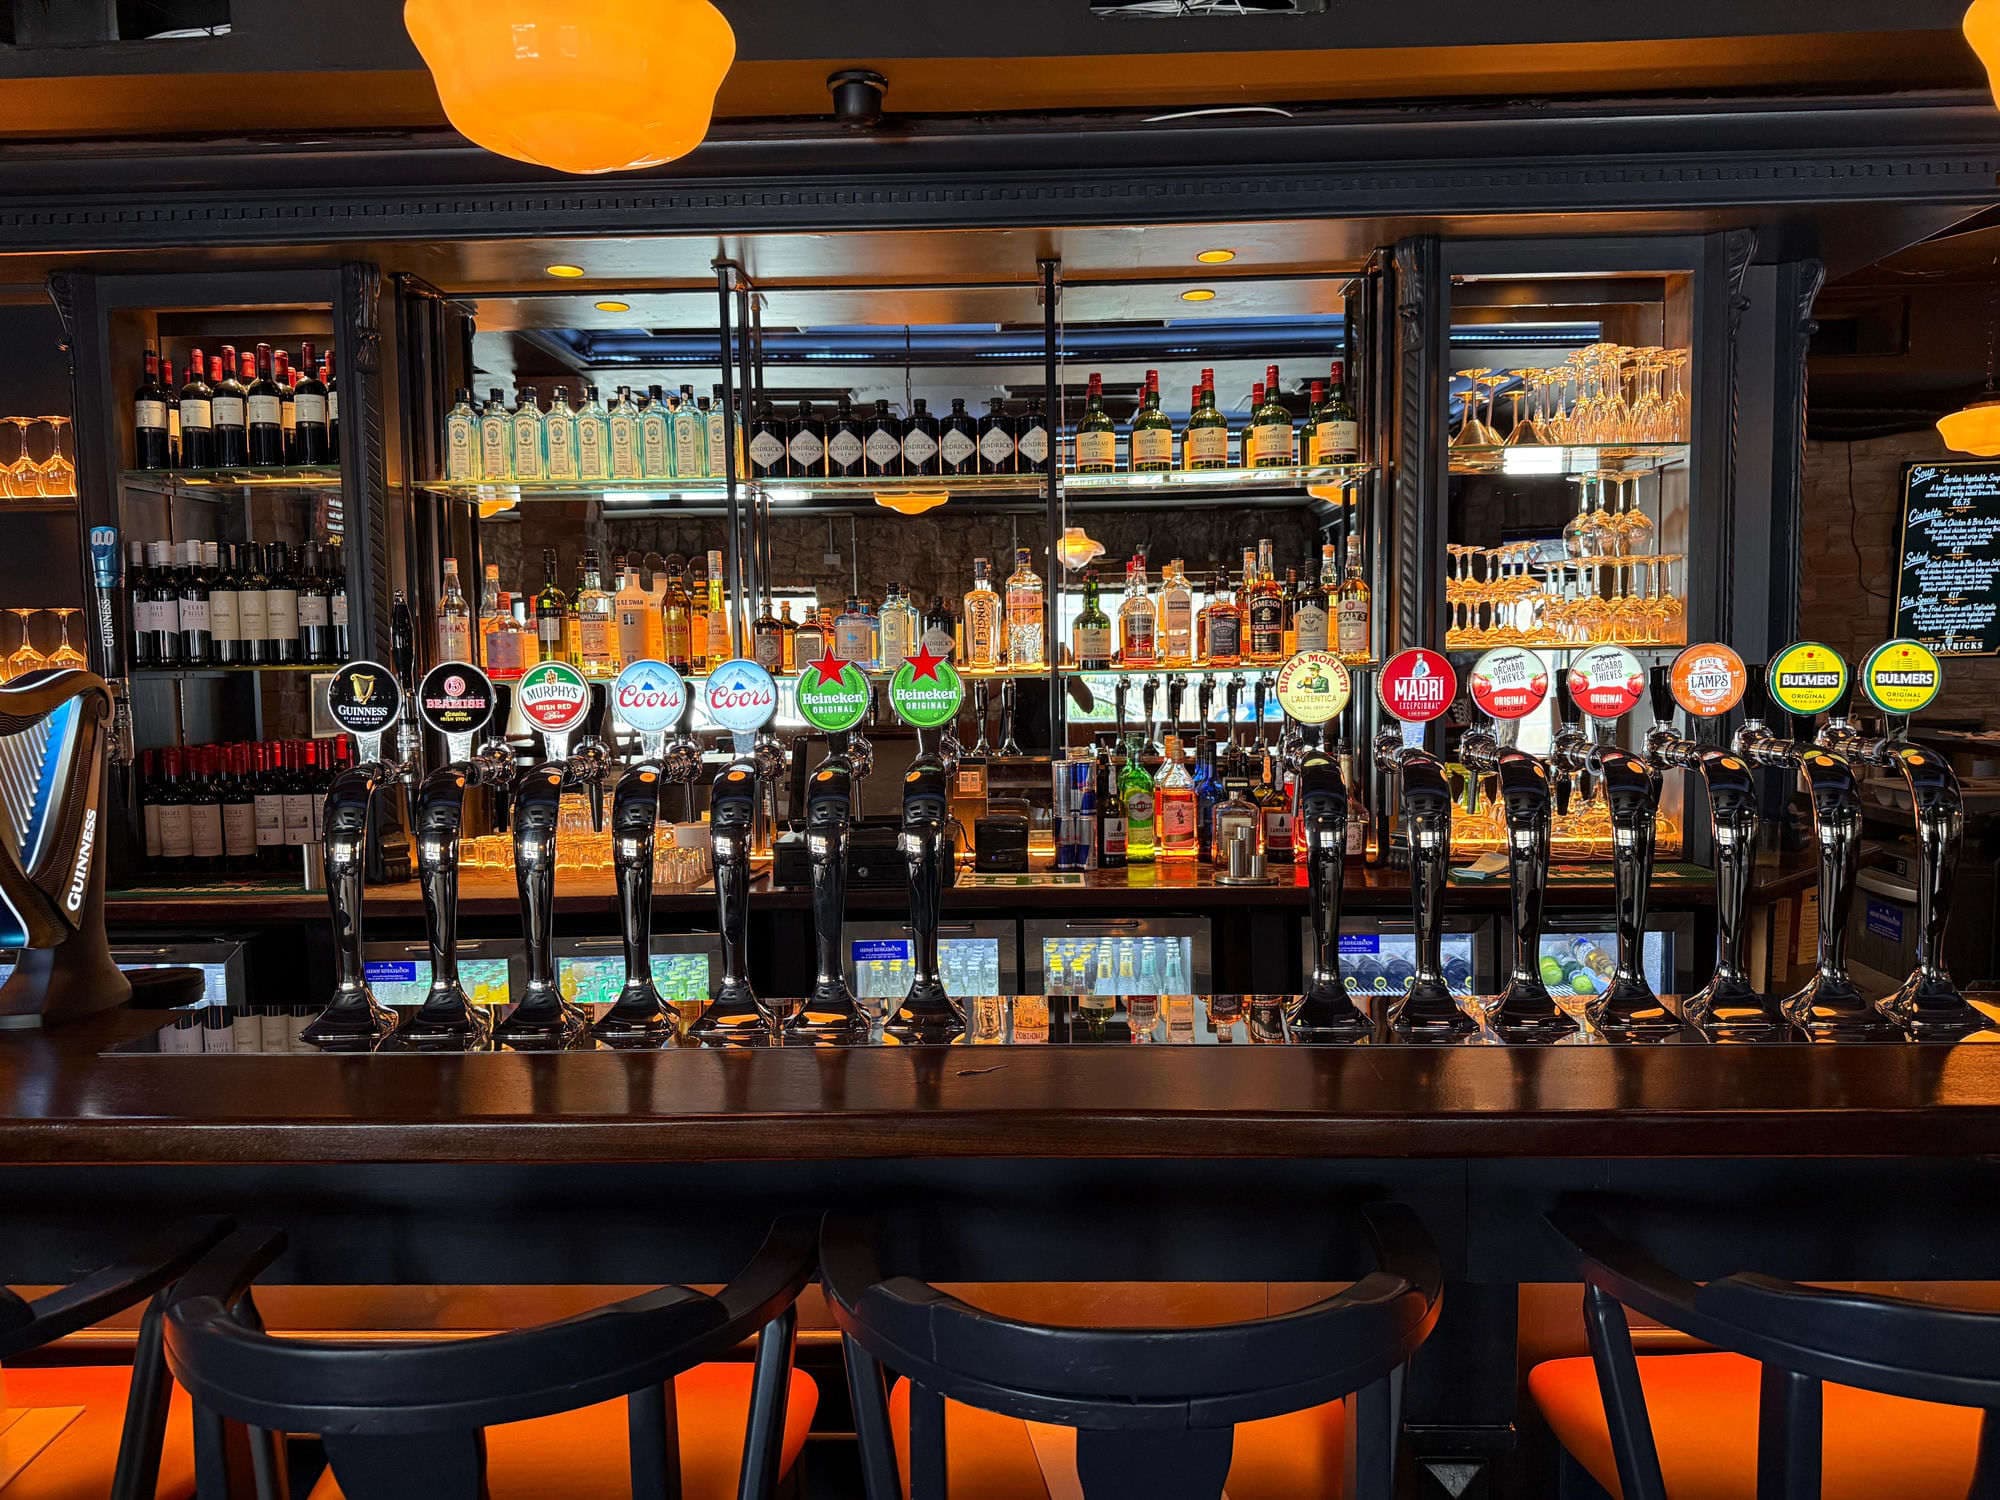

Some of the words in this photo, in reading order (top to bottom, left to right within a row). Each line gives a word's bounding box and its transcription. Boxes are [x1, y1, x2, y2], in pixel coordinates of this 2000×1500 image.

[1912, 467, 1936, 483] Soup
[1963, 474, 1987, 484] Vegetable
[1908, 507, 1942, 523] Ciabatta
[1948, 518, 1966, 527] Chicken
[92, 530, 114, 545] 0.0
[1904, 551, 1929, 566] Salad
[1252, 600, 1280, 610] JAMESON
[1900, 596, 1915, 608] Fish
[1916, 594, 1938, 606] Special
[101, 598, 113, 647] GUINNESS
[977, 600, 986, 638] DINGLE
[1925, 642, 1983, 651] ZPATRICKS
[1494, 661, 1525, 676] ORCHARD
[1592, 660, 1623, 673] ORCHARD
[1279, 657, 1306, 693] BIRRA
[1308, 654, 1348, 693] MORETTI
[1497, 671, 1526, 685] THIEVES
[1595, 669, 1623, 683] THIEVES
[1782, 674, 1838, 686] BULMERS
[1876, 673, 1933, 685] BULMERS
[1691, 674, 1729, 689] LAMPS
[618, 684, 680, 708] Coors
[709, 685, 772, 709] Coors
[802, 692, 863, 704] Heineken
[896, 688, 957, 701] Heineken
[1494, 695, 1527, 706] ORIGINAL
[1590, 693, 1623, 704] ORIGINAL
[338, 704, 388, 716] GUINNESS
[426, 698, 486, 709] BEAMISH
[813, 705, 855, 714] ORIGINAL
[905, 701, 949, 710] ORIGINAL
[67, 808, 97, 911] GUINNESS
